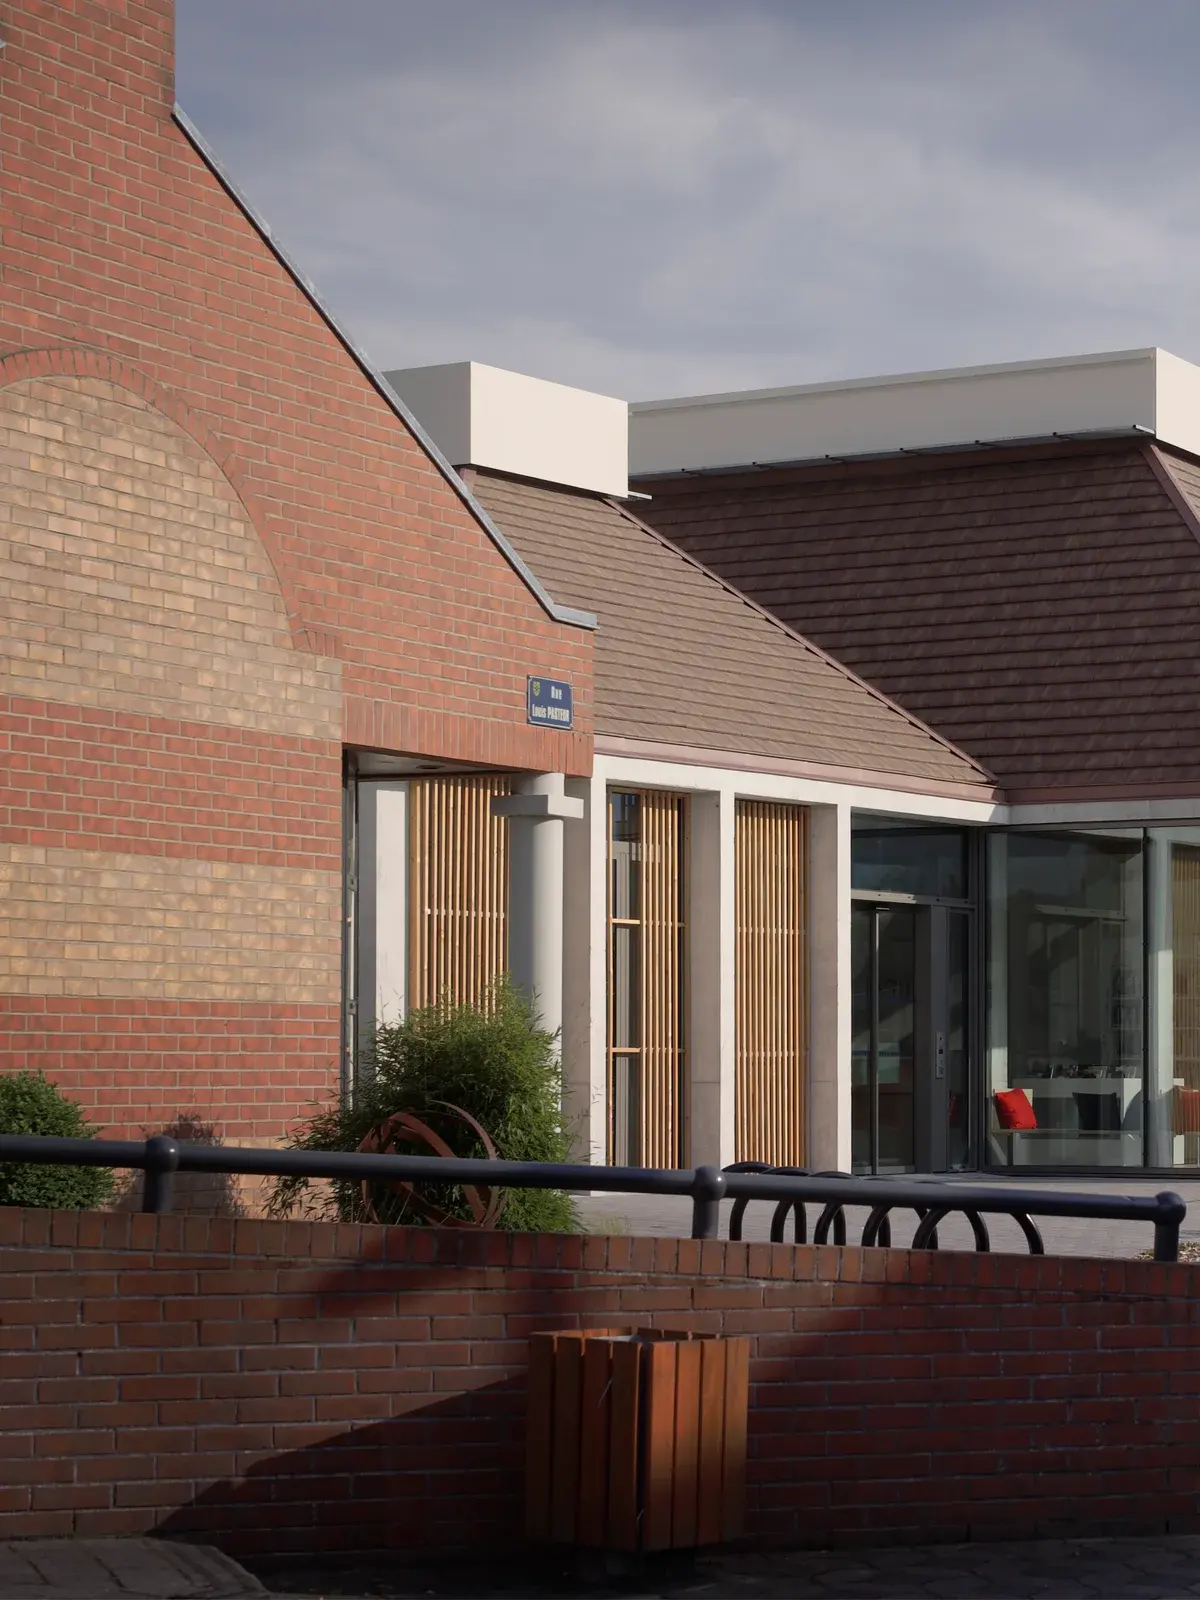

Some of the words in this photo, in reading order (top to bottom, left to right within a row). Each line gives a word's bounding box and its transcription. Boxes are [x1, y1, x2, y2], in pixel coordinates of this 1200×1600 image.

[551, 686, 562, 700] Rue
[532, 704, 547, 718] Louis
[547, 706, 570, 722] PASTEUR
